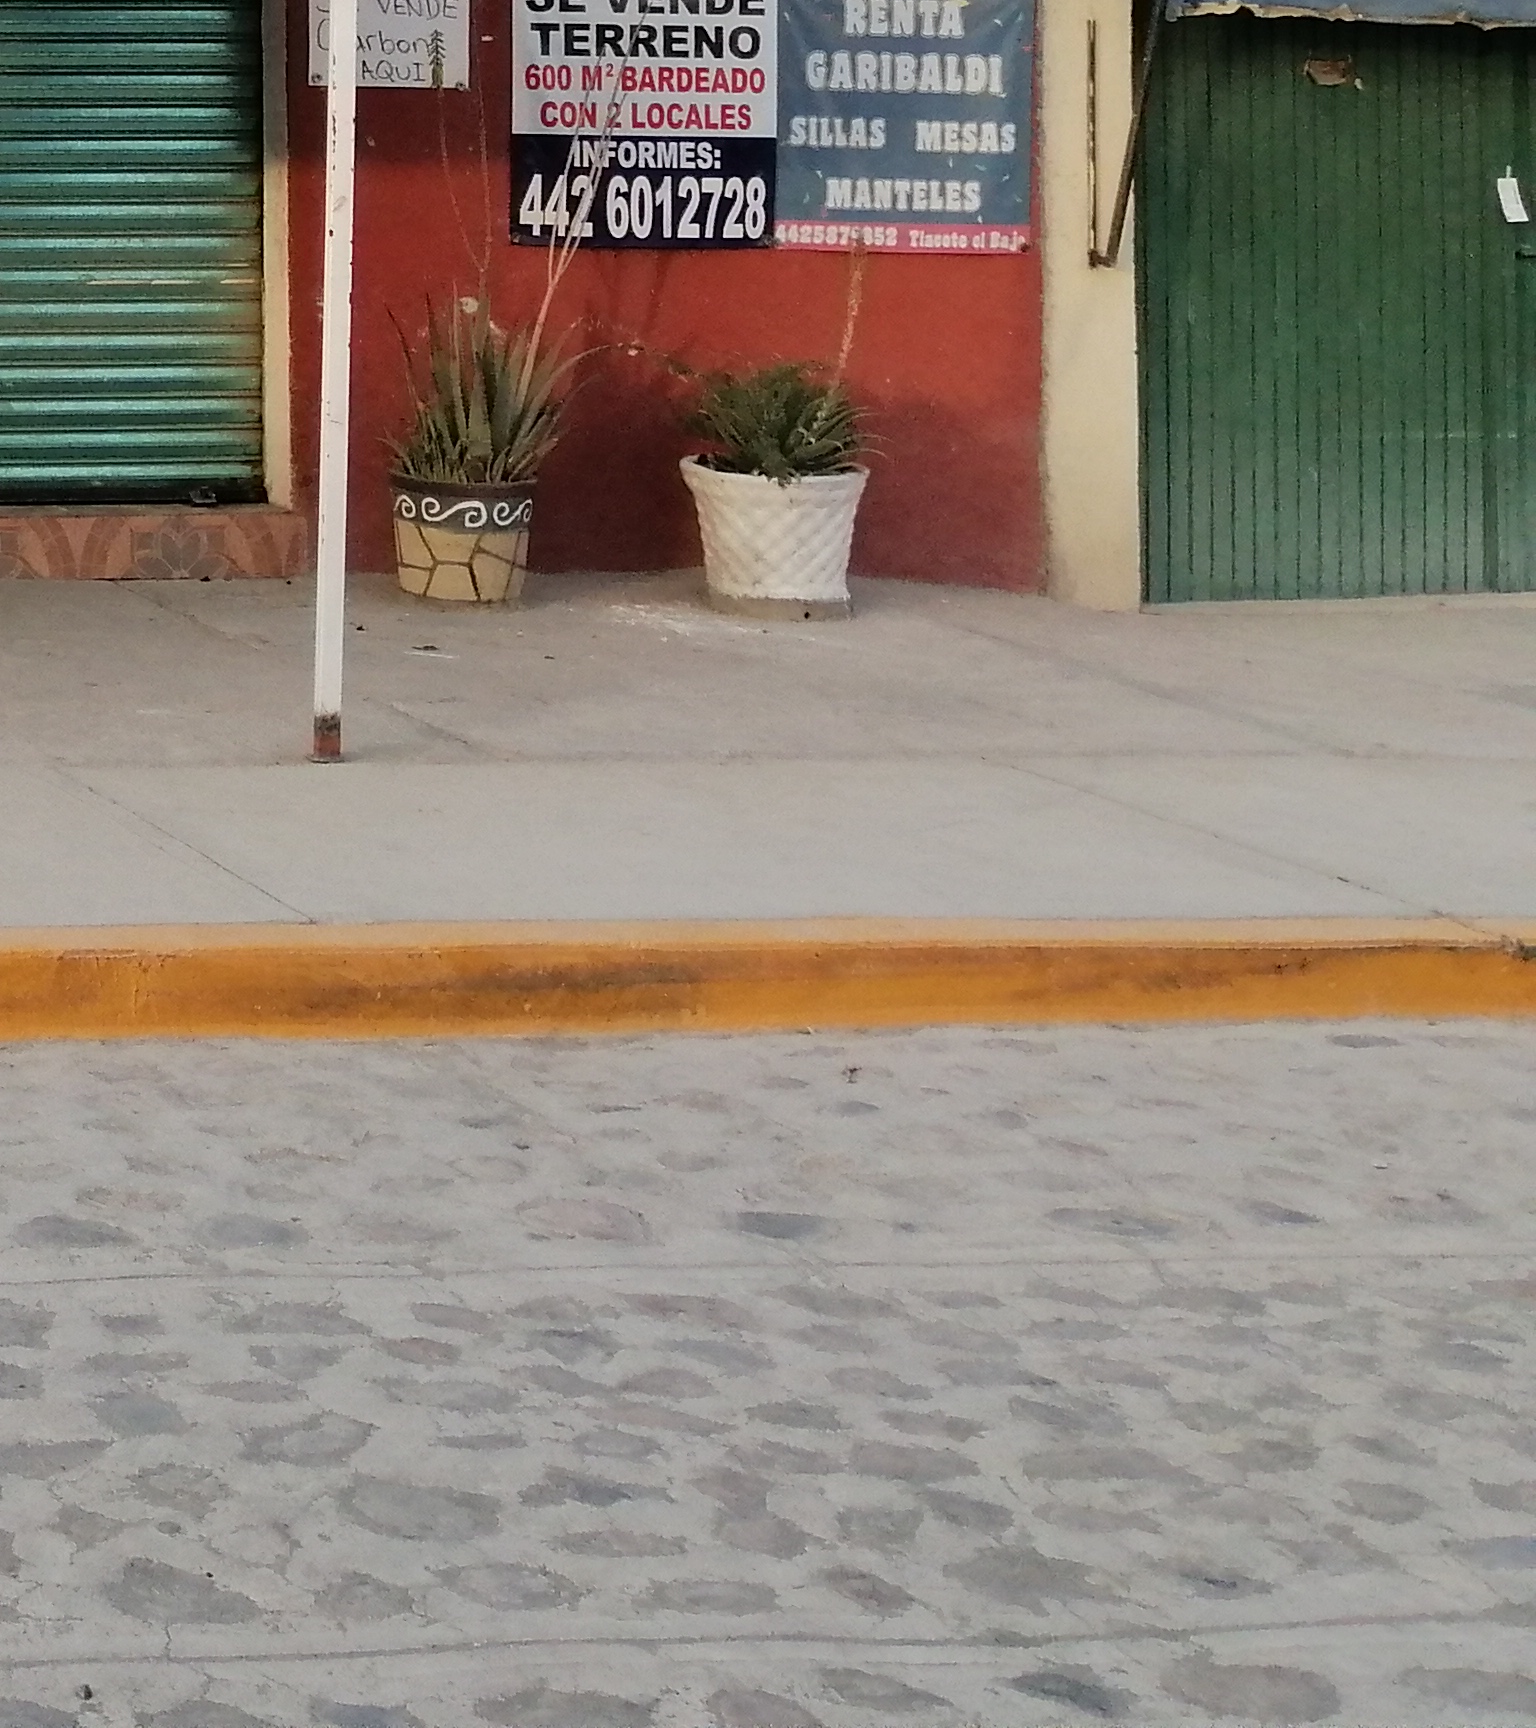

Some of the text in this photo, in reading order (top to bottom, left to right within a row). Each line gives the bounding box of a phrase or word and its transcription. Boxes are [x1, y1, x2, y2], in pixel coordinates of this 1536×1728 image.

[530, 23, 762, 59] TERRENO
[361, 59, 427, 83] AQUI
[524, 63, 573, 92] 600
[620, 66, 766, 94] BARDEADO
[805, 49, 1004, 95] GARIBALDI
[540, 100, 752, 131] CON 2 LOCALES
[789, 115, 1017, 154] SILLAS MESAS
[572, 140, 722, 170] INFORMES:
[518, 173, 767, 240] 442 6012728
[825, 177, 982, 212] MANTELES
